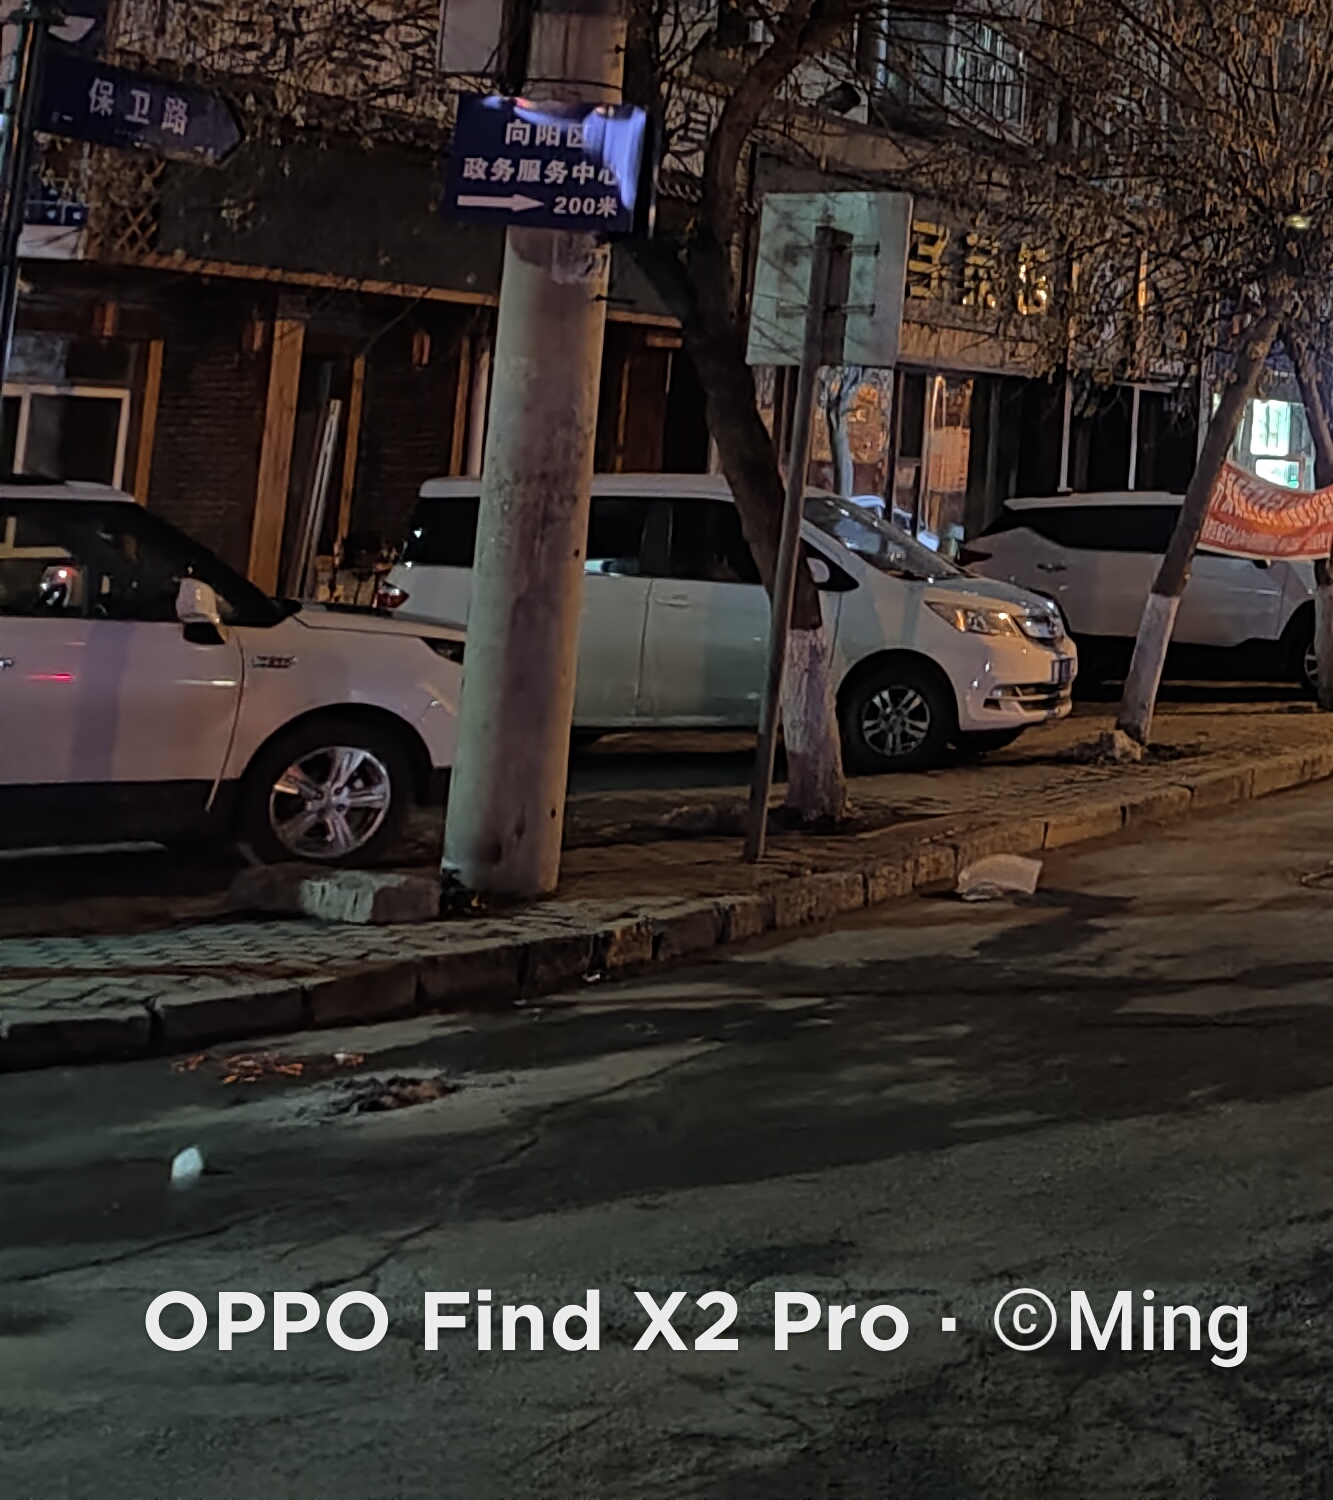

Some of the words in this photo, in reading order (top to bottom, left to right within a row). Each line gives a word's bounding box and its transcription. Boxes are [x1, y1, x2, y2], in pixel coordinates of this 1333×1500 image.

[88, 77, 188, 136] 保卫路
[504, 119, 593, 149] 向阳区
[462, 156, 619, 187] 政务服务中心
[552, 195, 619, 218] 200米
